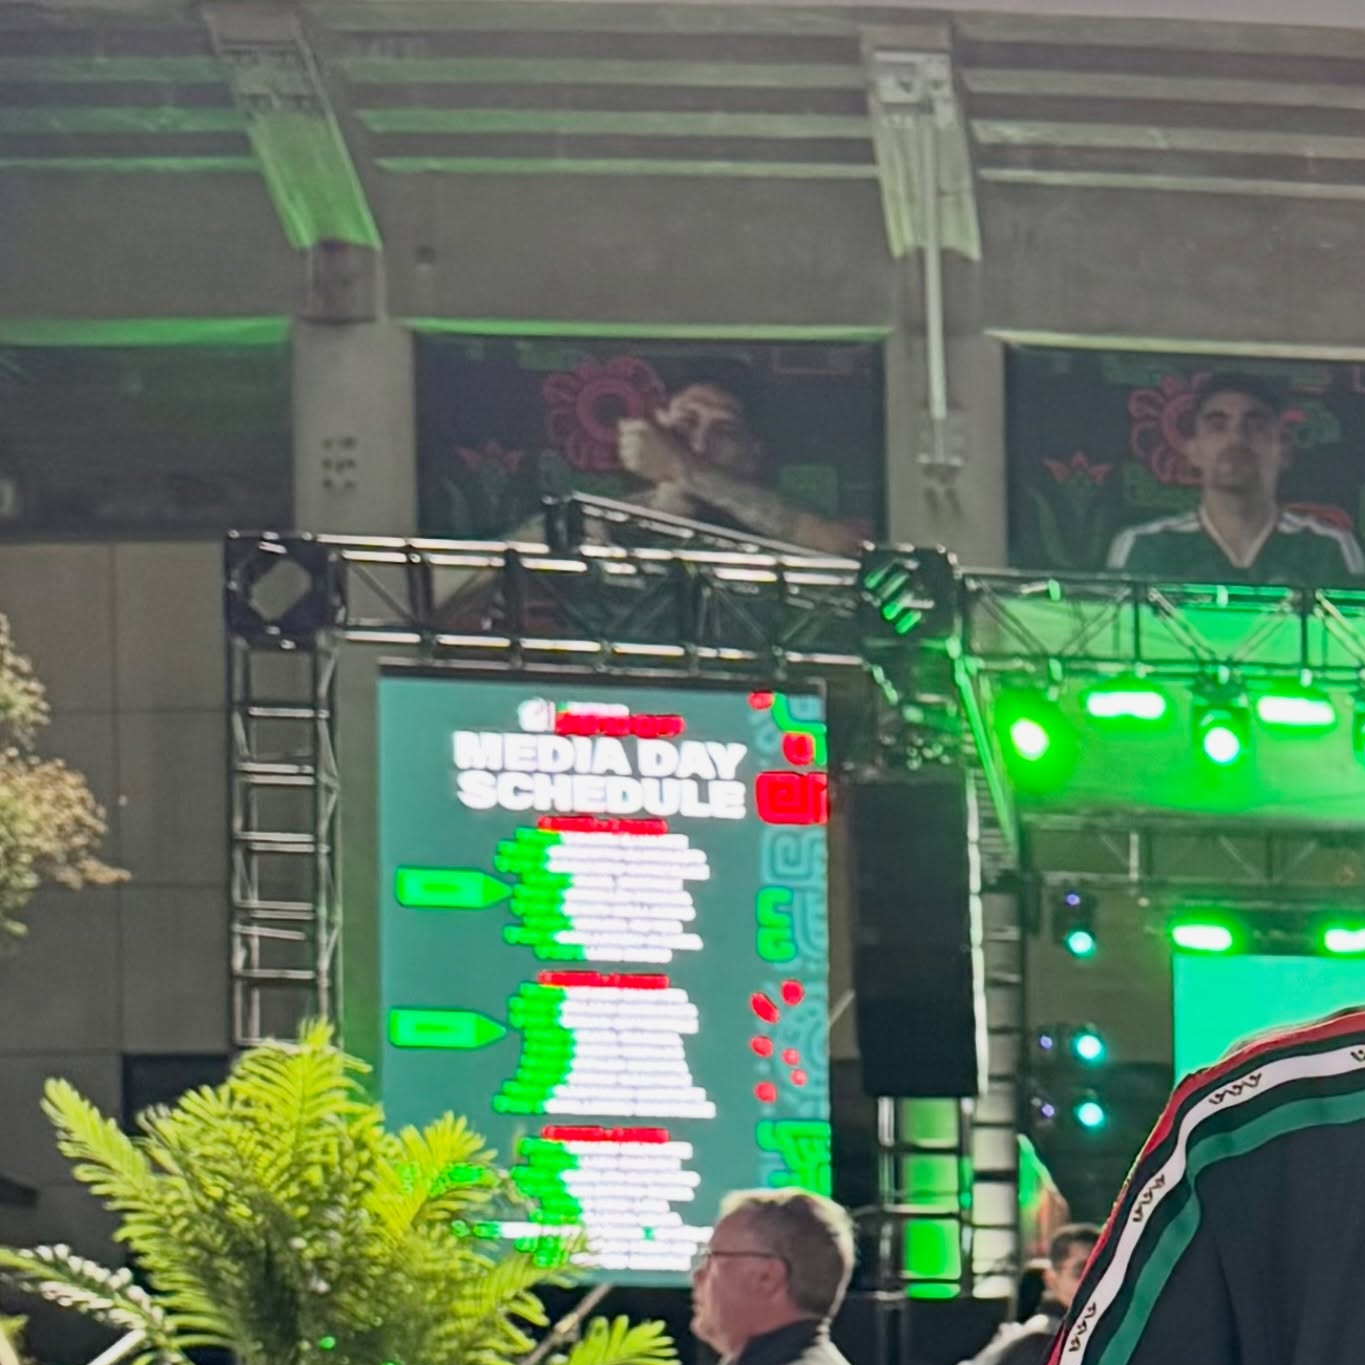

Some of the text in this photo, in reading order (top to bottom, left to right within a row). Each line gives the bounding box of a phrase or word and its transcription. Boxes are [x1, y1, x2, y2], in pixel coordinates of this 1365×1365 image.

[453, 730, 748, 781] MEDIA DAY
[456, 769, 747, 819] SCHEDULE
